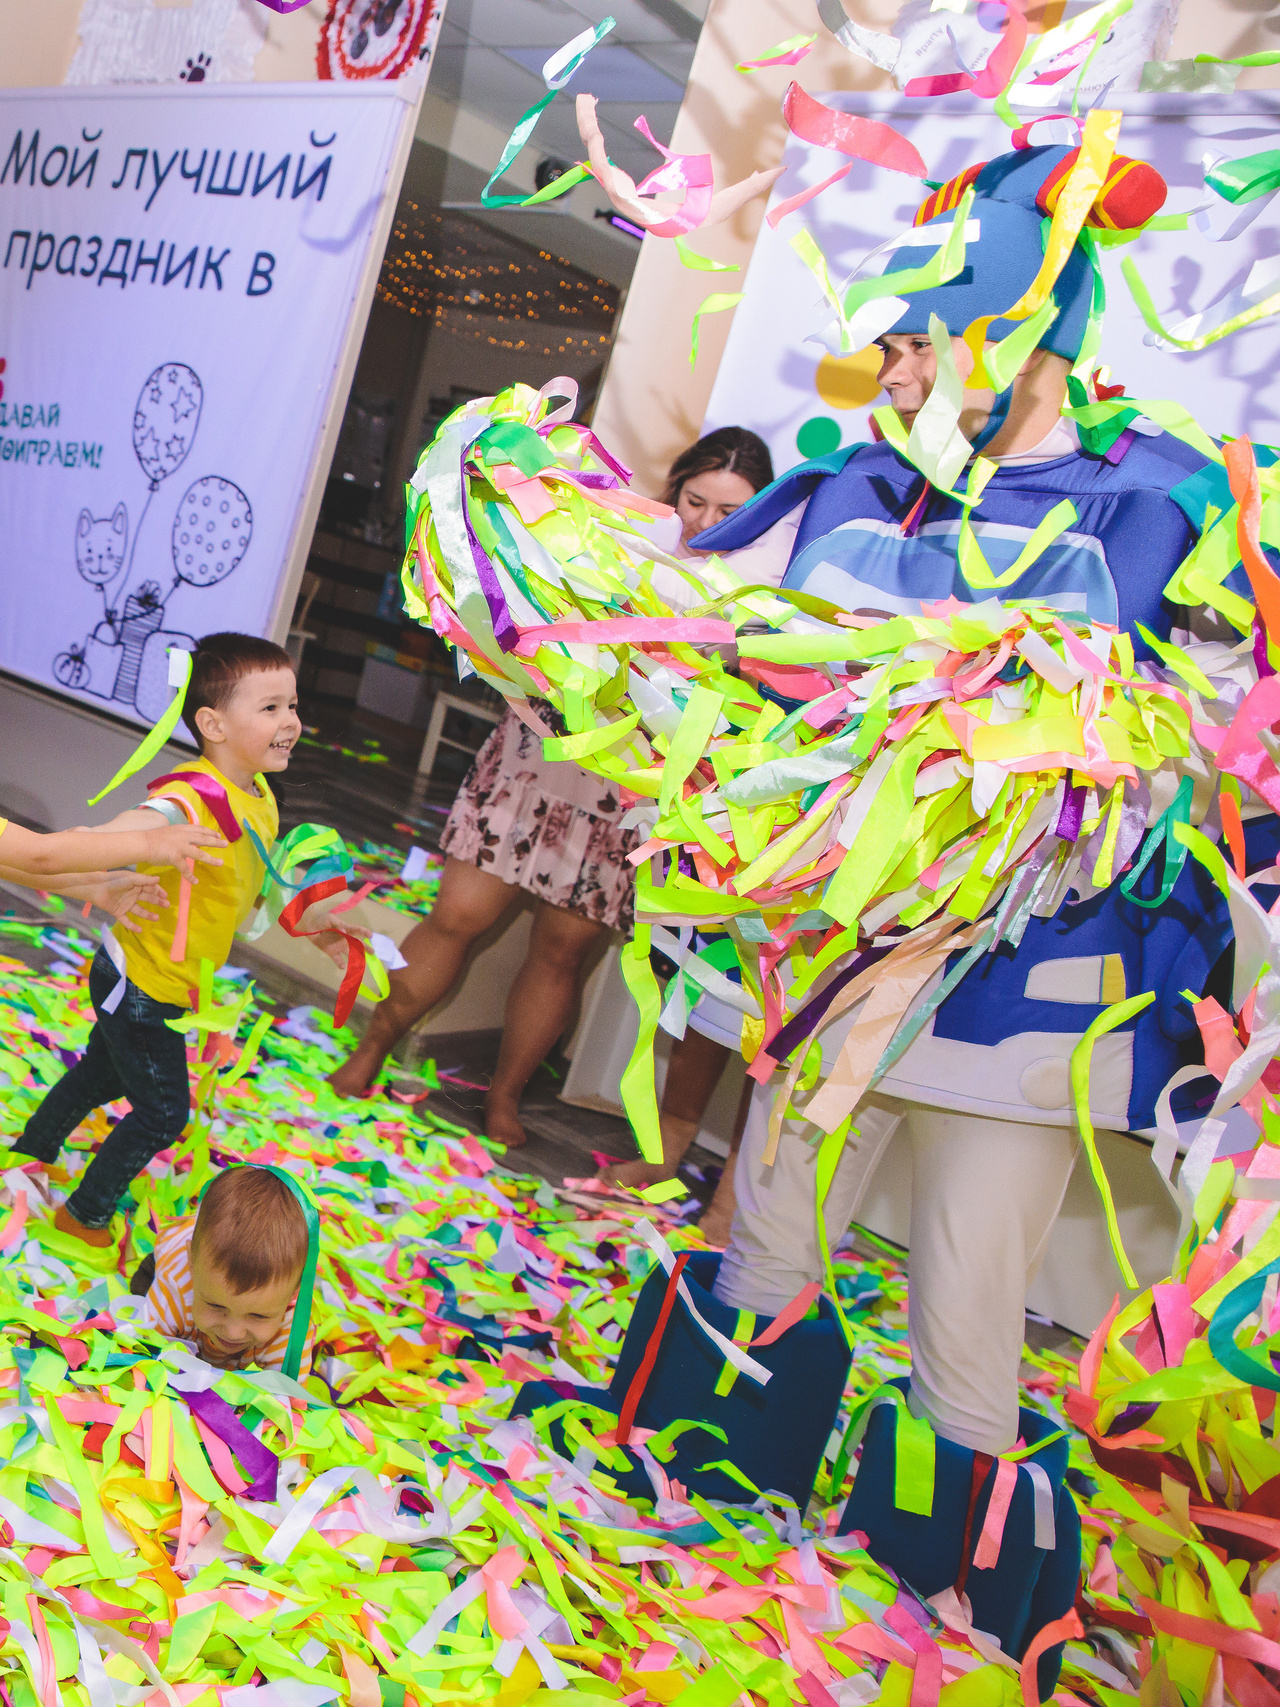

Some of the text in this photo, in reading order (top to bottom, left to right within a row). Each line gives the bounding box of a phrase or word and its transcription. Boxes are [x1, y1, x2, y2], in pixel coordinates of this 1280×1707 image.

[0, 127, 337, 212] Мой лучший
[3, 229, 276, 296] праздник в
